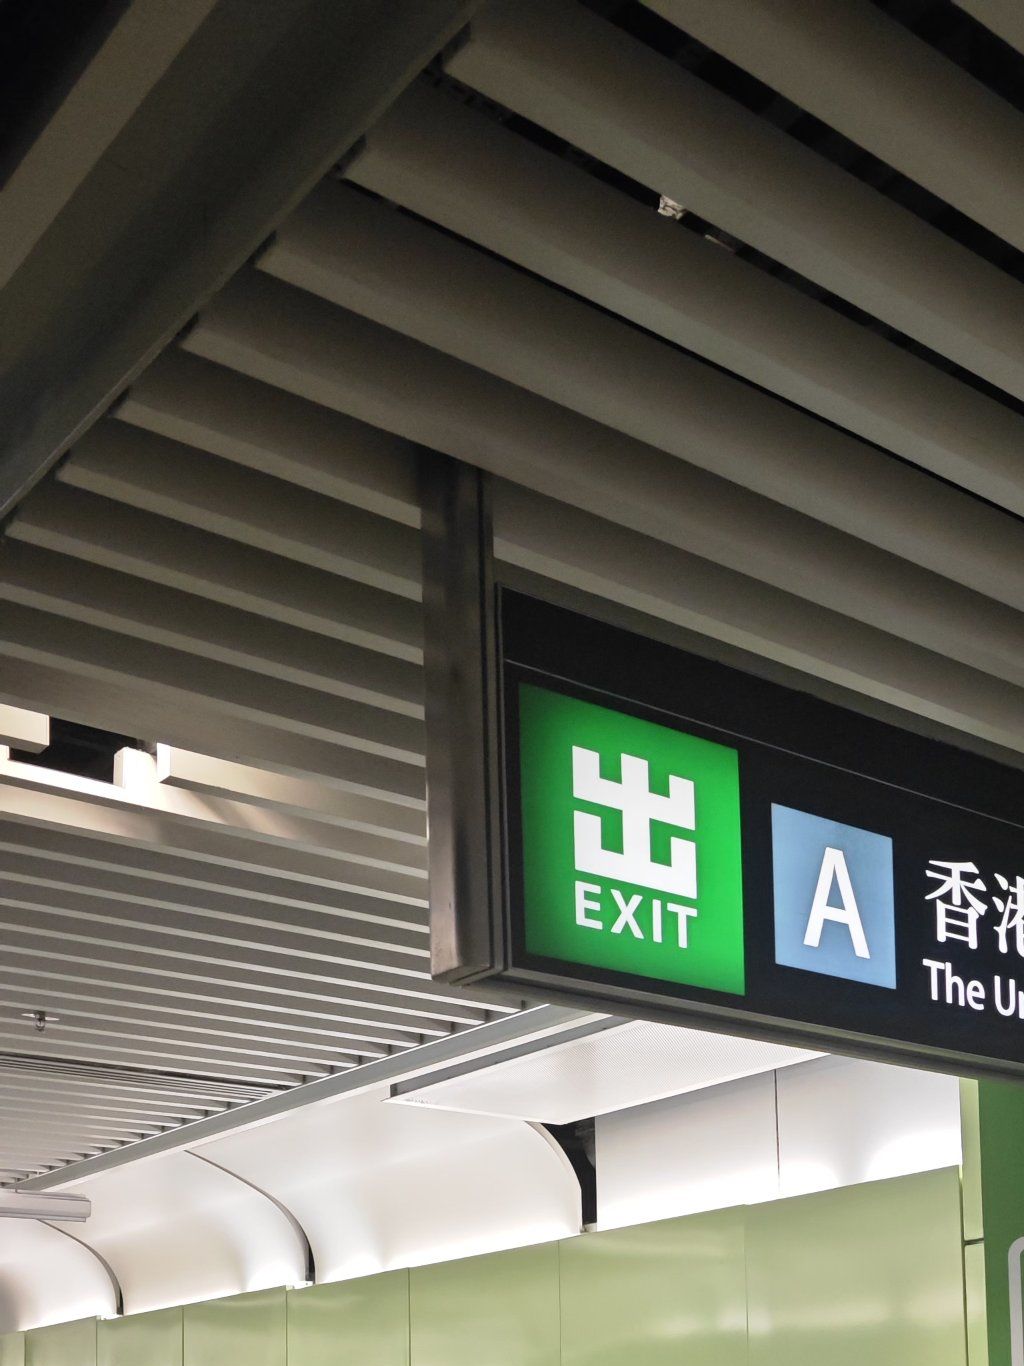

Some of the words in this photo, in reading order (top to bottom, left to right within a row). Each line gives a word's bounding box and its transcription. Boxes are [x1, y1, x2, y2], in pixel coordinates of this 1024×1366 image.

[574, 880, 698, 949] EXIT
[802, 846, 871, 960] A
[922, 958, 986, 1011] The
